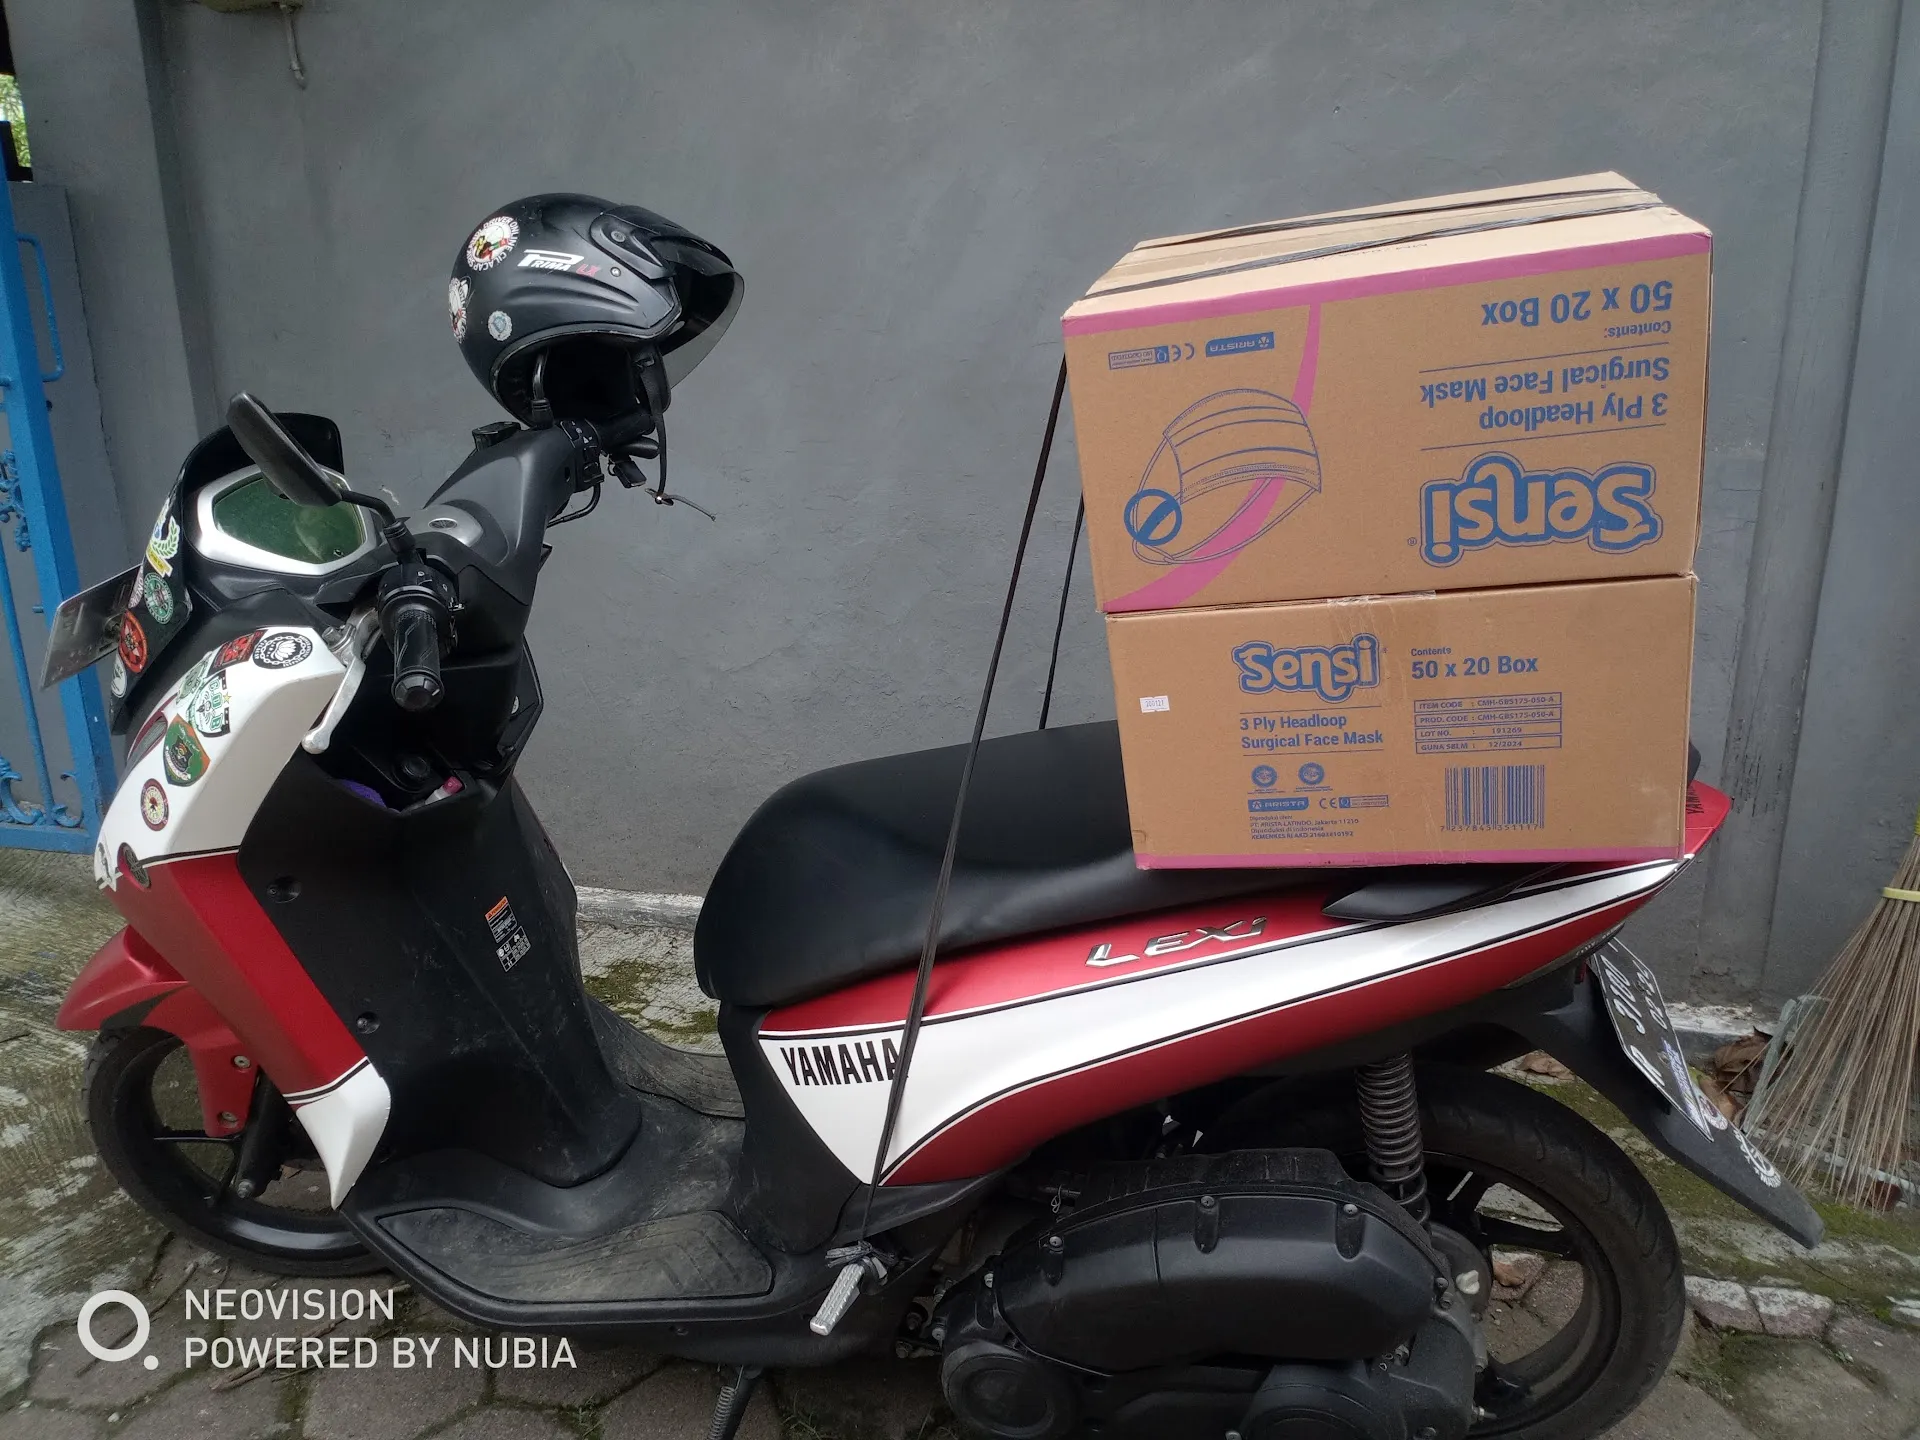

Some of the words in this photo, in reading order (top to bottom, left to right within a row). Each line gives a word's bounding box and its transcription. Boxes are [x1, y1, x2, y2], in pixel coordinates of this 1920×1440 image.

[483, 216, 514, 229] DRIVER
[506, 222, 520, 252] ONLINE
[473, 252, 507, 271] CILACAP
[517, 249, 585, 271] PRIMA
[576, 264, 601, 278] LX
[1550, 289, 1592, 322] 20
[1601, 287, 1620, 312] x
[1630, 280, 1673, 316] 50
[1480, 298, 1541, 330] Box
[1603, 320, 1672, 340] Contents:
[1209, 340, 1255, 352] ARISTA
[1494, 372, 1552, 398] Face
[1562, 353, 1669, 393] Surgical
[1419, 378, 1486, 407] Mask
[1604, 392, 1643, 422] Ply
[1652, 393, 1667, 416] 3
[1479, 400, 1594, 434] Headloop
[1419, 451, 1663, 569] Sensi
[1411, 648, 1452, 656] Contents
[1231, 633, 1380, 704] Sensi
[1412, 661, 1438, 679] 50
[1445, 663, 1456, 677] x
[1464, 657, 1490, 675] 20
[1498, 656, 1538, 674] Box
[1240, 718, 1249, 731] 3
[1254, 717, 1275, 731] Ply
[1280, 714, 1347, 729] Headloop
[1241, 734, 1300, 750] Surgical
[1304, 735, 1339, 746] Face
[1344, 730, 1383, 744] Mask
[1265, 800, 1305, 808] ARISTA
[1085, 915, 1268, 968] LEXI
[779, 1037, 904, 1086] YAMAHA
[1630, 1045, 1665, 1087] R
